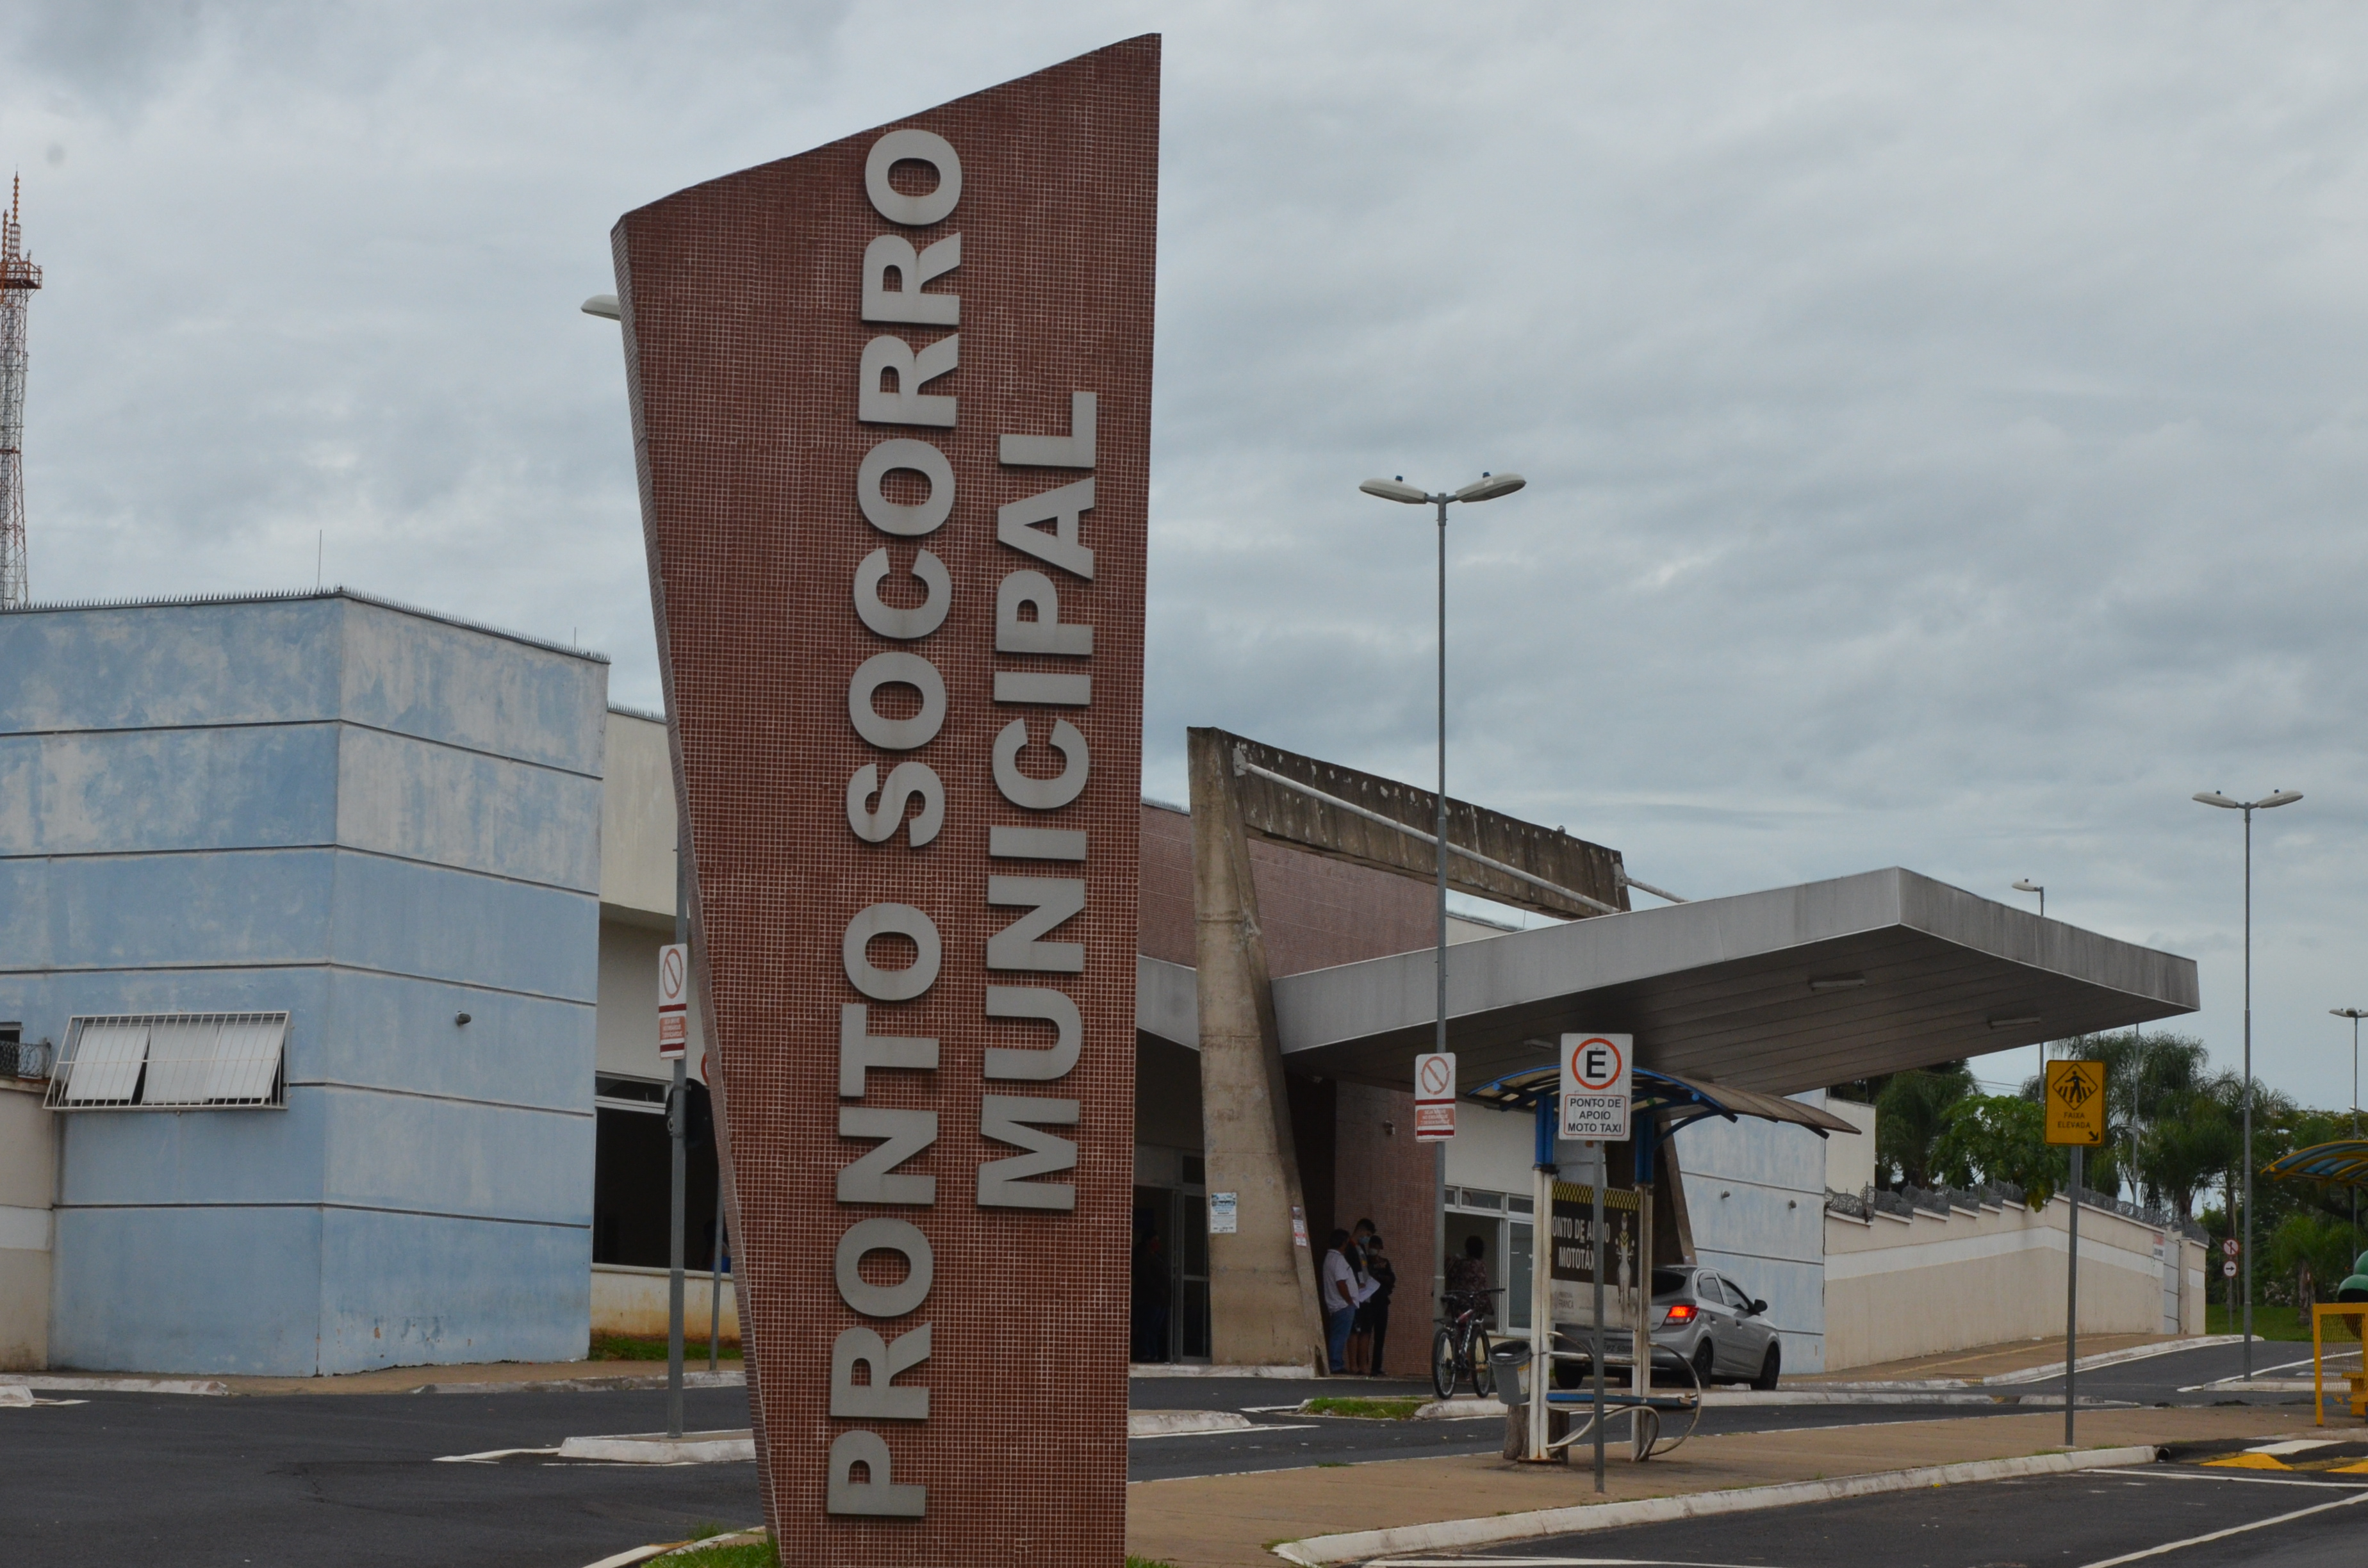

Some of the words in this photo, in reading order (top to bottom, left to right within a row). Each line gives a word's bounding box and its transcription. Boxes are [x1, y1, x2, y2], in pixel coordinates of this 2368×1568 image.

[846, 128, 962, 847] SOCORRO
[976, 389, 1098, 1211] MUNICIPAL
[1586, 1050, 1606, 1078] E
[1570, 1098, 1605, 1107] PONTO
[1607, 1098, 1622, 1107] DE
[1579, 1111, 1611, 1120] APOIO
[1568, 1123, 1597, 1132] MOTO
[1600, 1123, 1622, 1132] TAXI
[826, 901, 942, 1517] PRONTO
[1552, 1216, 1573, 1239] ONTO
[1574, 1218, 1585, 1241] DE
[1558, 1245, 1594, 1271] MOTOTÁX
